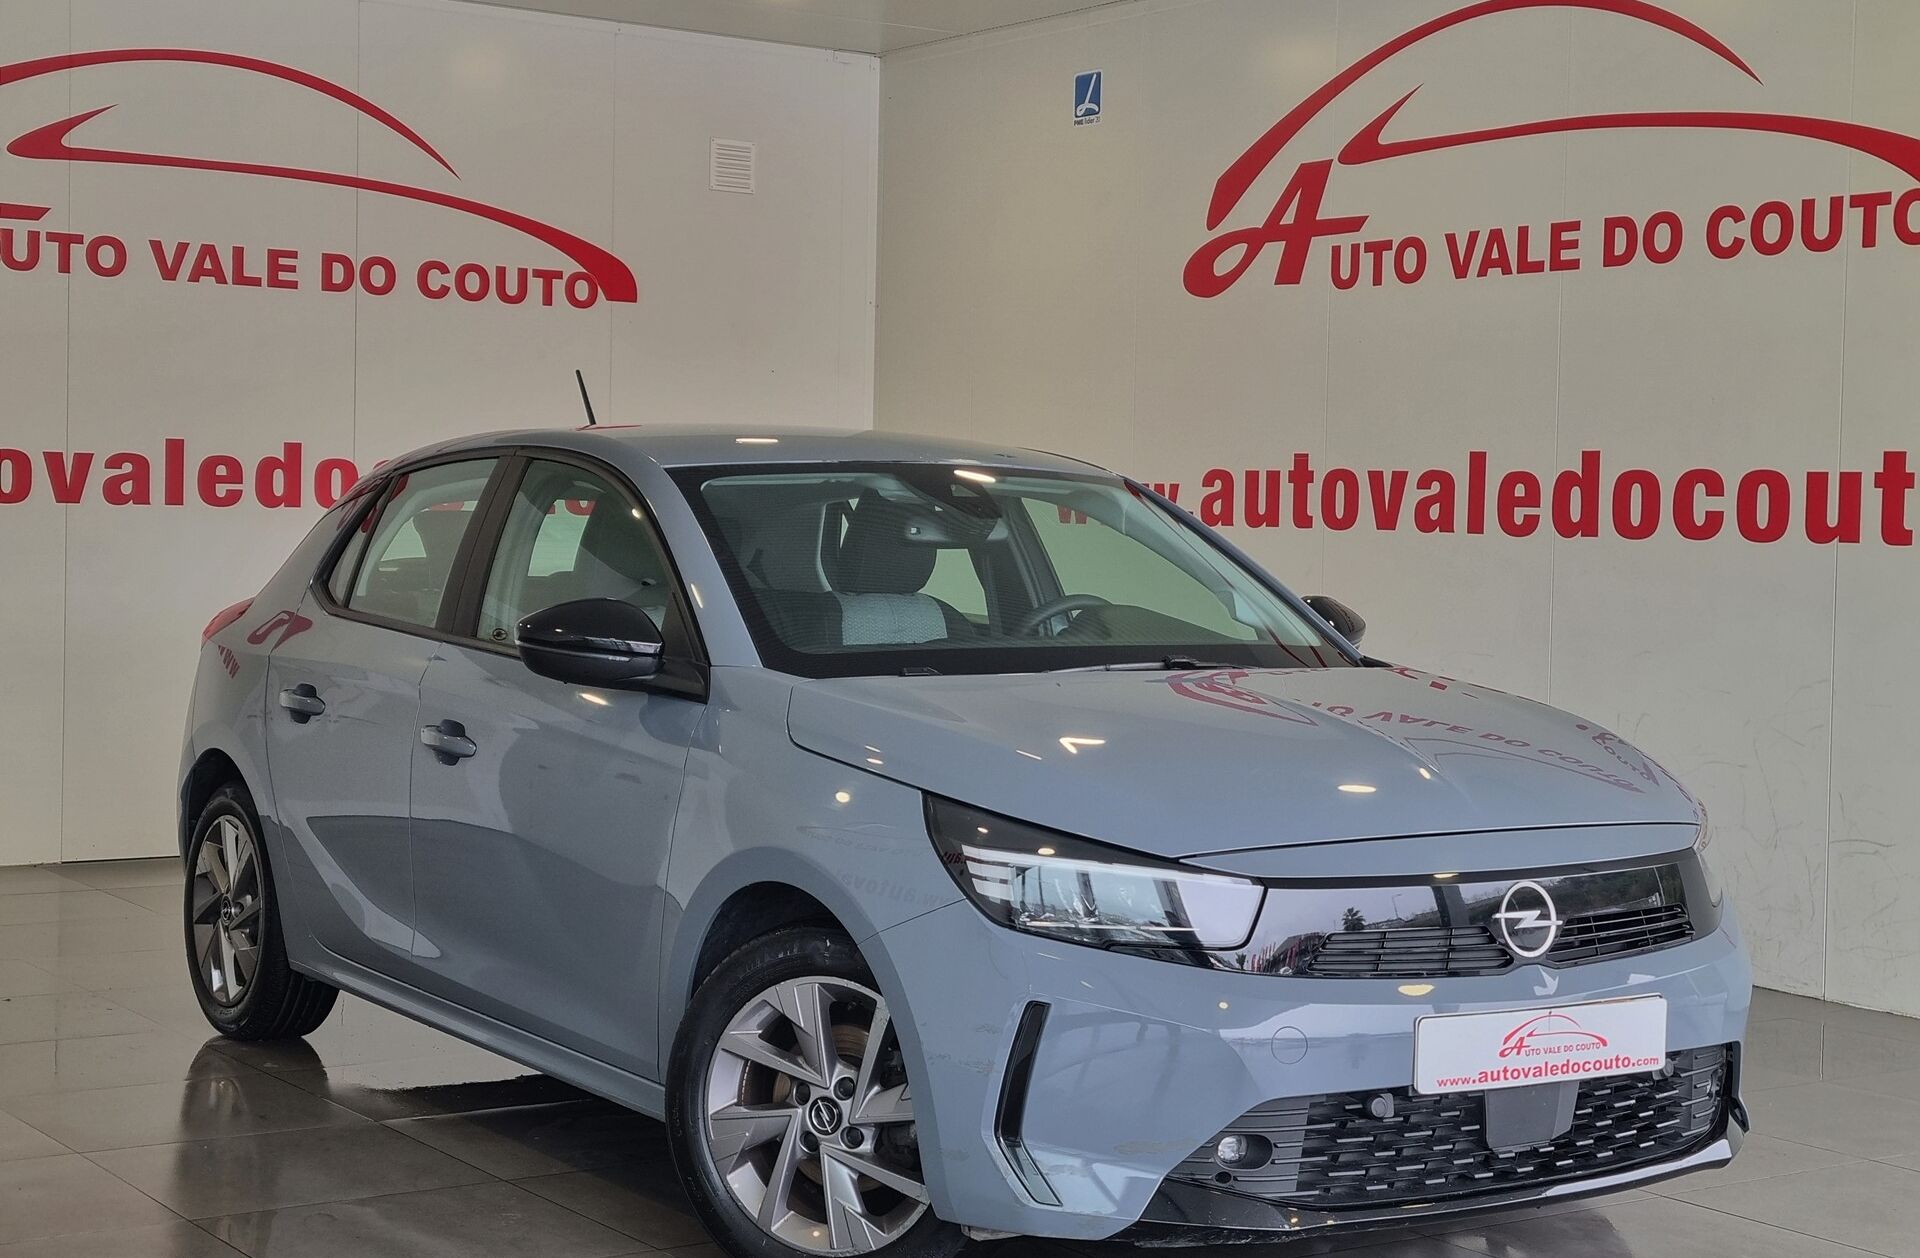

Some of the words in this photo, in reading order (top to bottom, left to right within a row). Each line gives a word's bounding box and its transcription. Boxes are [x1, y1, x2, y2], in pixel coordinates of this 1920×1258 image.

[0, 203, 127, 277] UTO
[149, 239, 299, 289] VALE
[321, 252, 396, 296] DO
[417, 260, 599, 309] COUTO
[1445, 221, 1581, 279] VALE
[1603, 211, 1683, 268] DO
[1706, 187, 1920, 260] COUTO
[1436, 1053, 1659, 1088] www.autovaledocouto.com
[1543, 1046, 1561, 1055] VALE
[1563, 1044, 1574, 1053] DO
[1575, 1042, 1601, 1052] COUTO
